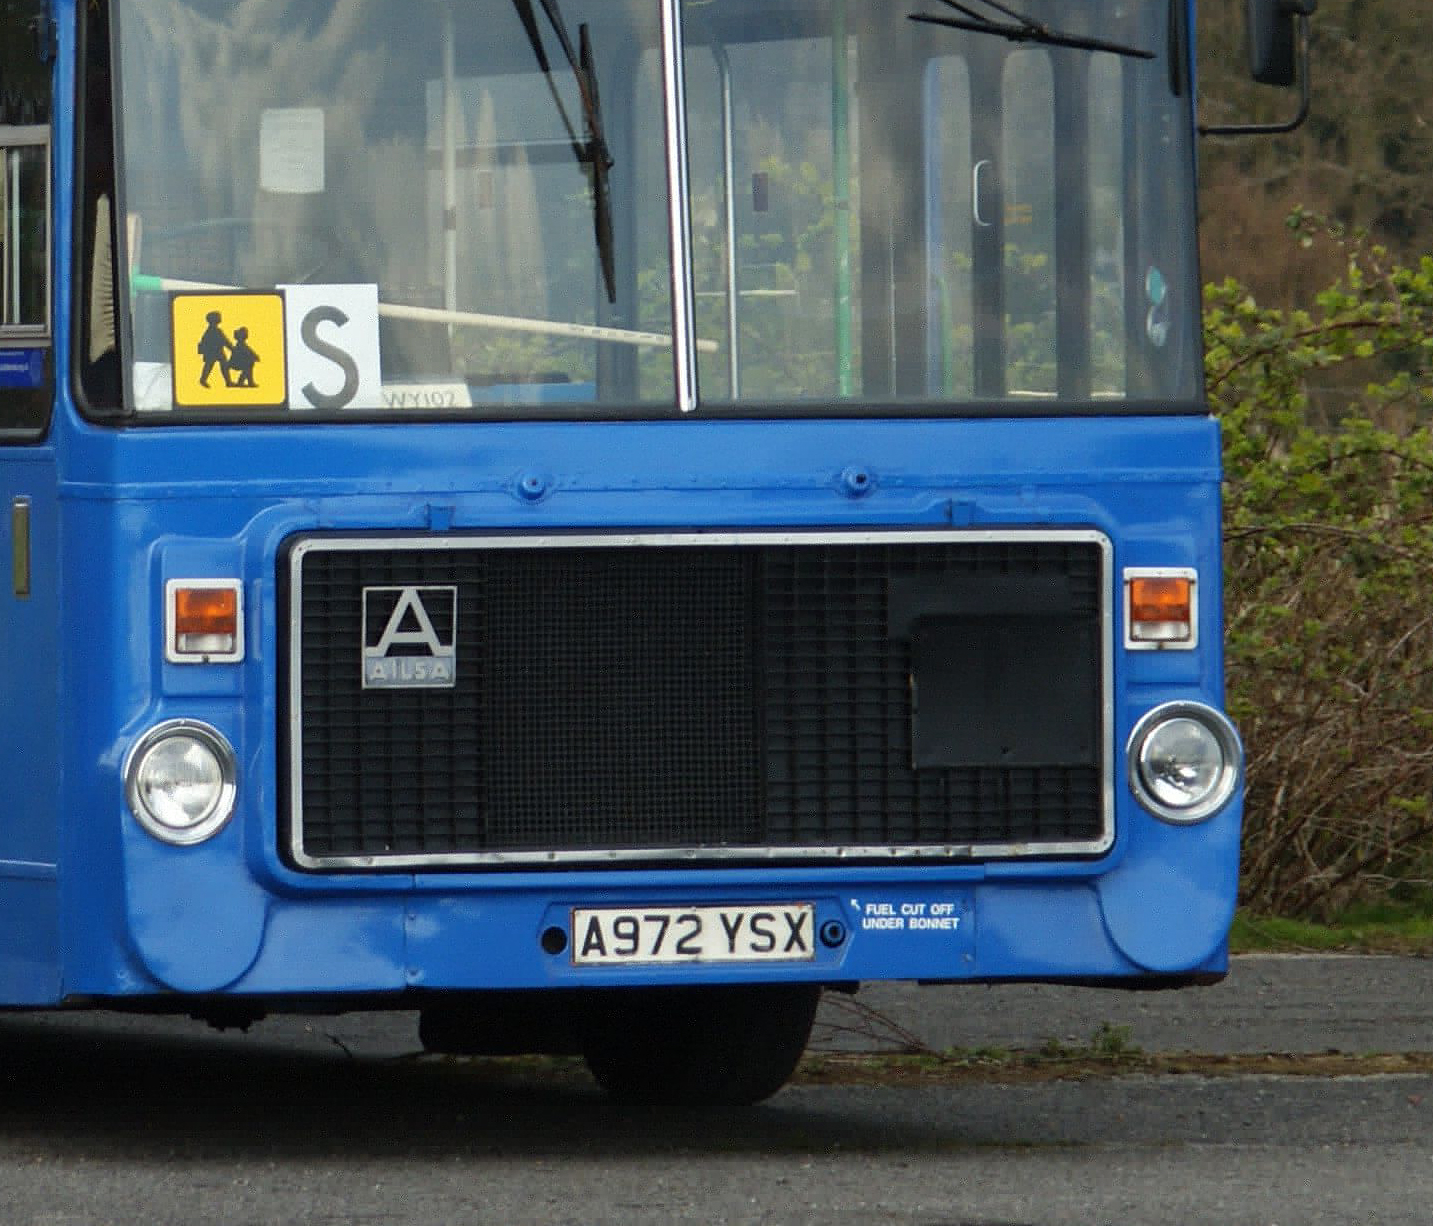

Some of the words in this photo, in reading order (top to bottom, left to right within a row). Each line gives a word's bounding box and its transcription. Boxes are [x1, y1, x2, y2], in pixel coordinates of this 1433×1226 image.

[301, 305, 359, 409] S
[366, 586, 453, 657] A
[369, 659, 449, 681] AILSA
[863, 917, 905, 930] UNDER
[909, 917, 960, 930] BONNET
[866, 903, 897, 916] FUEL
[901, 903, 926, 916] CUT
[930, 903, 955, 916] OFF
[581, 913, 703, 956] A972
[721, 912, 809, 953] YSX
